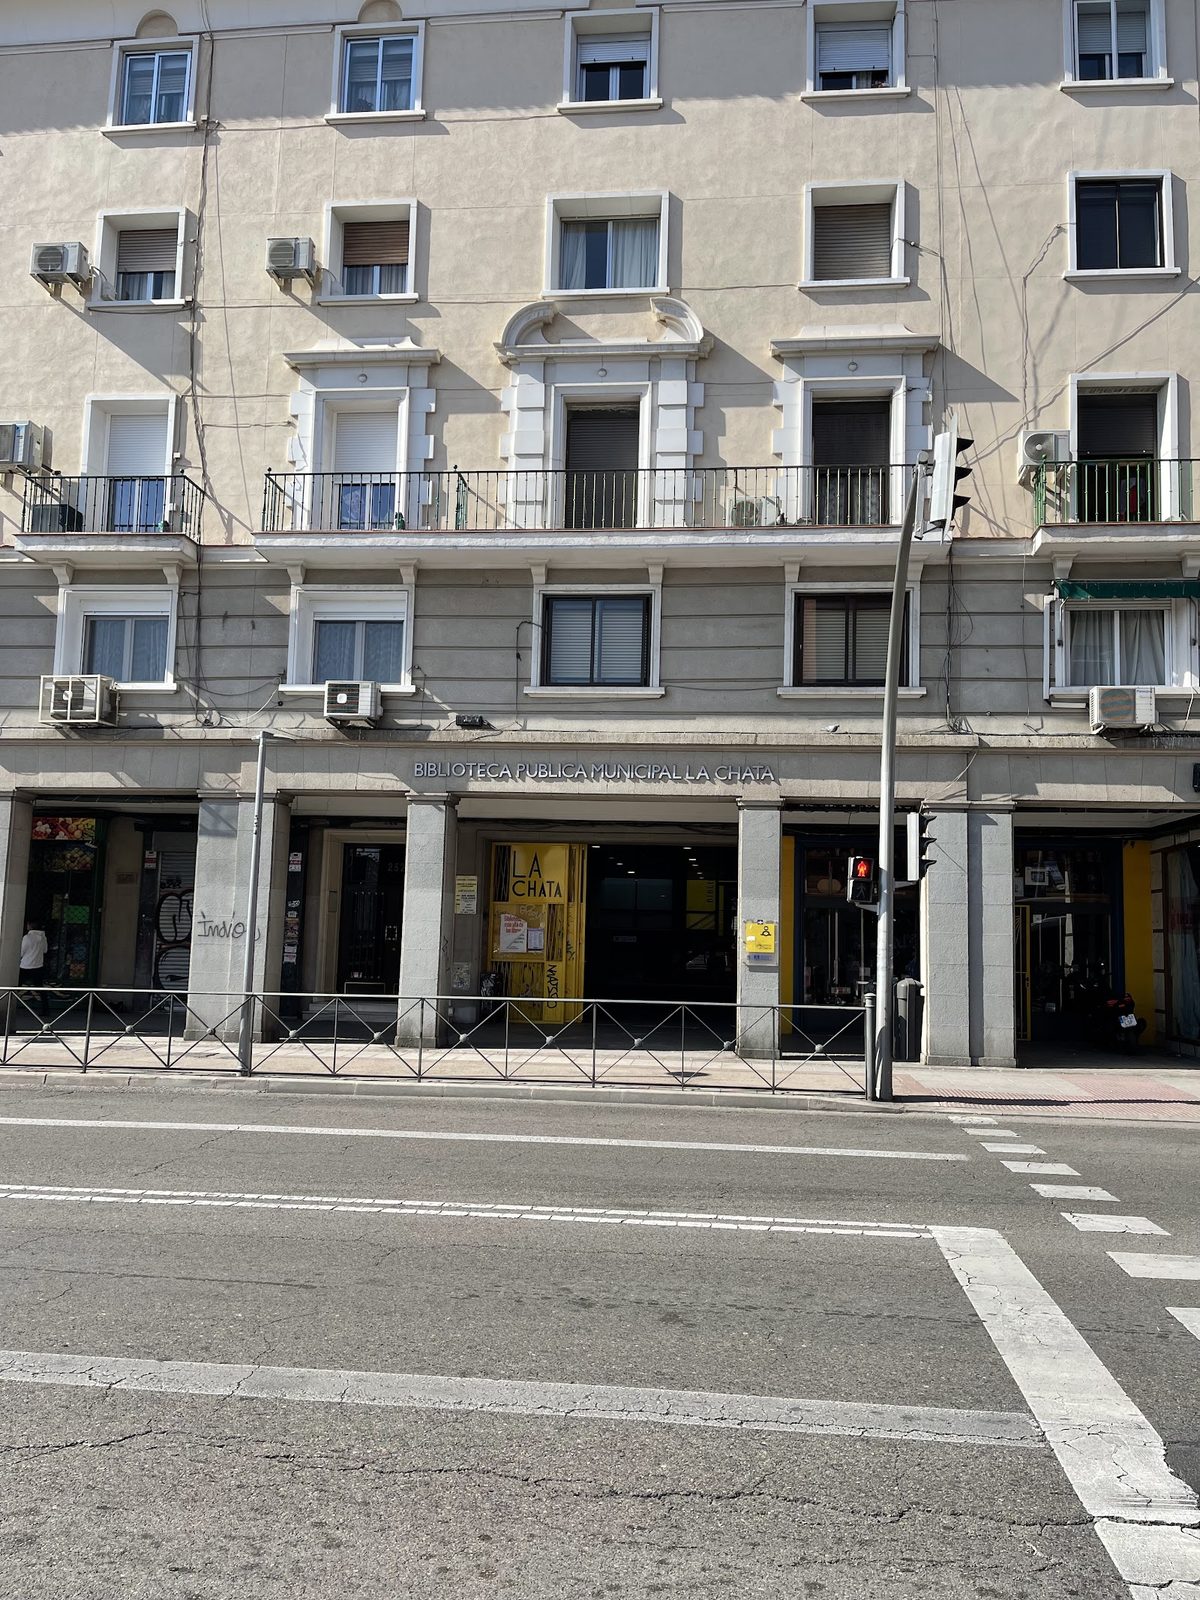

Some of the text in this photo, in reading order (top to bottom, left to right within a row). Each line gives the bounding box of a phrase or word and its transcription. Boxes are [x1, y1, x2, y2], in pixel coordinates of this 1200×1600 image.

[414, 762, 775, 781] BIBLIOTECA PUBLICA MUNICIPAL LA CHATA
[512, 850, 542, 878] LA
[512, 880, 562, 898] CHATA
